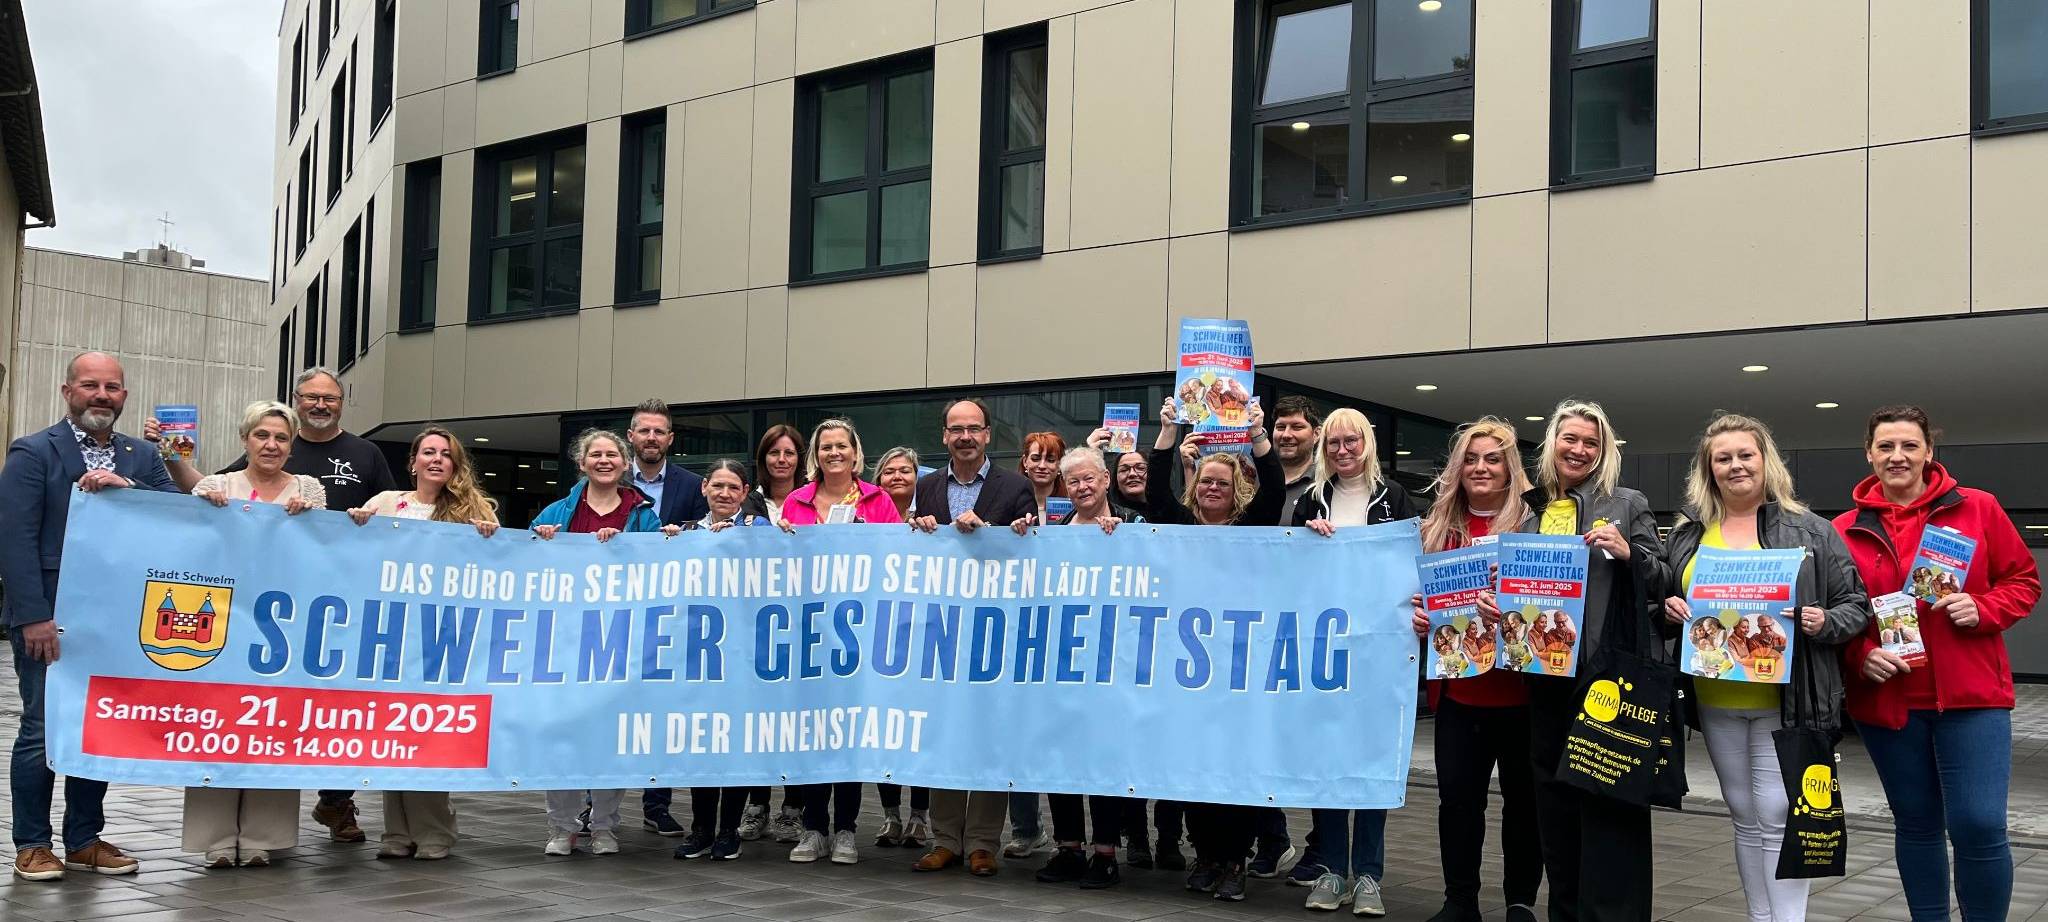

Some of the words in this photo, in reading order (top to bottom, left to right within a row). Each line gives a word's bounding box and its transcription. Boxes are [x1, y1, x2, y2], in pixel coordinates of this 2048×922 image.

[1194, 331, 1243, 344] SCHWELMER
[1182, 342, 1252, 356] GESUNDHEITSTAG
[1515, 550, 1572, 564] SCHWELMER
[1434, 560, 1488, 580] SCHWELMER
[1502, 564, 1584, 580] GESUNDHEITSTAG
[1713, 562, 1782, 572] SCHWELMER
[146, 568, 180, 580] Stadt
[182, 571, 236, 586] Schwelm
[380, 560, 434, 596] DAS
[442, 563, 515, 602] BÜRO
[524, 568, 575, 602] FÜR
[584, 556, 803, 602] SENIORINNEN
[811, 554, 872, 595] UND
[882, 553, 1037, 600] SENIOREN
[1044, 561, 1102, 597] LÄDT
[1110, 565, 1160, 598] EIN:
[1425, 574, 1489, 595] GESUNDHEITST
[1540, 582, 1554, 590] Juni
[1696, 572, 1792, 584] GESUNDHEITSTAG
[1464, 592, 1476, 600] Juni
[248, 590, 726, 685] SCHWELMER
[753, 599, 1351, 694] GESUNDHEITSTAG
[95, 696, 226, 730] Samstag,
[236, 695, 288, 728] 21.
[298, 698, 377, 732] Juni
[384, 702, 477, 734] 2025
[1619, 702, 1658, 724] PFLEGE
[616, 712, 652, 755] IN
[665, 712, 731, 754] DER
[744, 706, 928, 754] INNENSTADT
[163, 732, 240, 754] 10.00
[247, 735, 286, 757] bis
[292, 736, 363, 760] 14.00
[370, 740, 418, 760] Uhr
